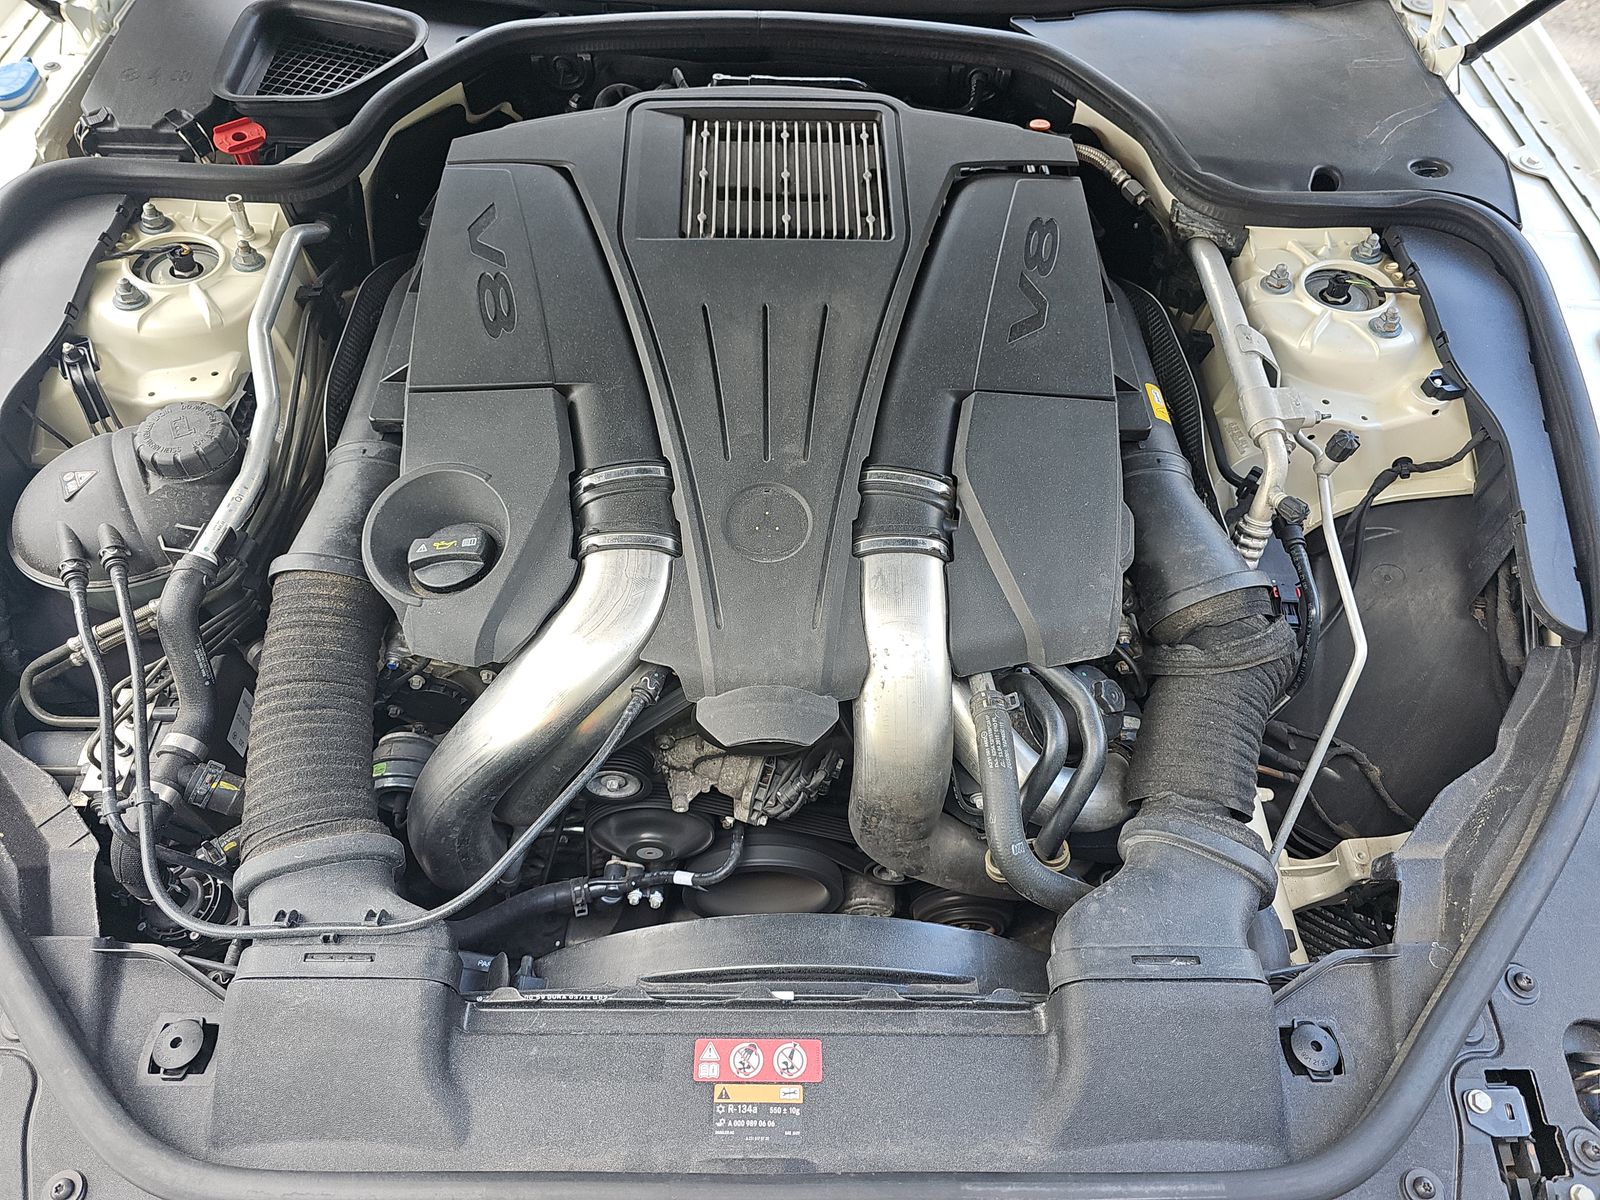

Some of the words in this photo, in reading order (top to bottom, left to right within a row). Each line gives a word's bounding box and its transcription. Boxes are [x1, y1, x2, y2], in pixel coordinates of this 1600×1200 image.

[467, 201, 517, 340] V8
[1006, 216, 1060, 345] V8
[728, 1104, 758, 1114] R-134a
[769, 1106, 781, 1114] 550
[789, 1106, 801, 1116] 10g
